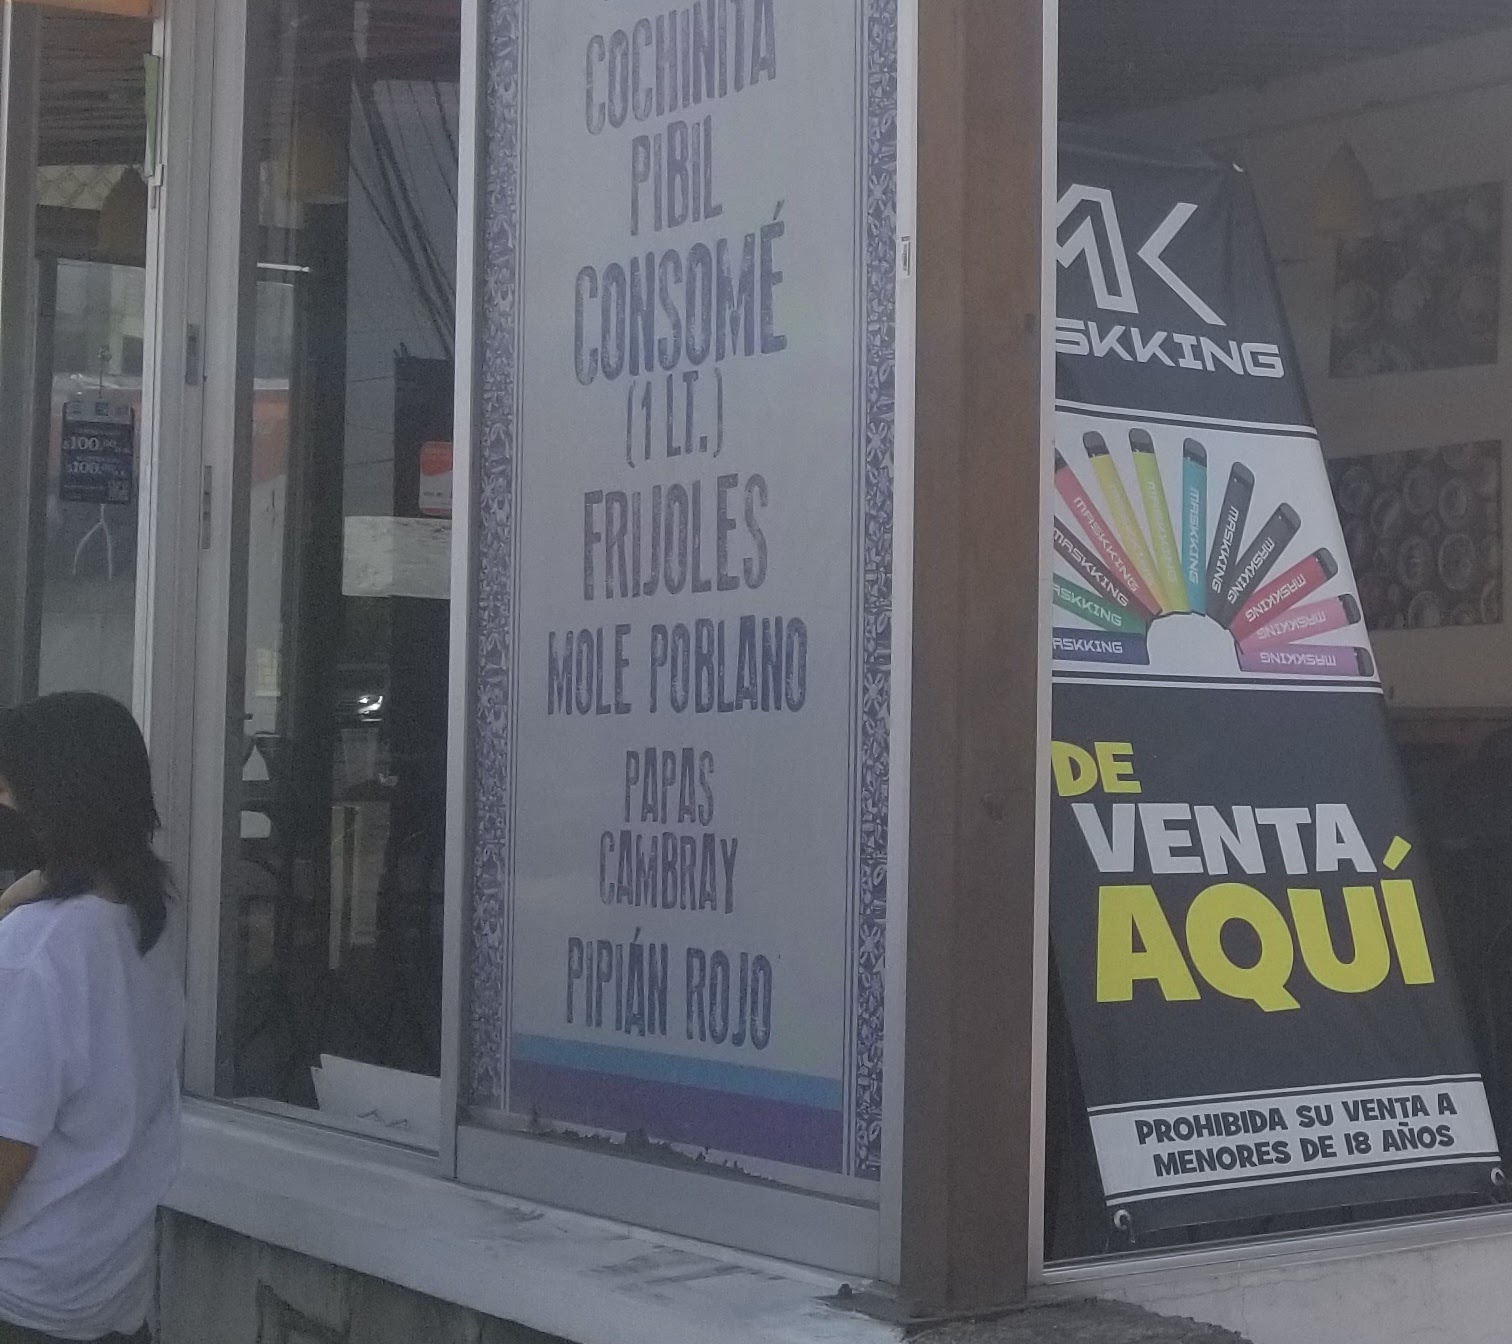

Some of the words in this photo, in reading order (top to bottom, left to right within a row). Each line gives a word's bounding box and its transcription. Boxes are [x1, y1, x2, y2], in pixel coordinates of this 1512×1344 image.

[630, 114, 723, 237] PIBIL
[574, 199, 788, 386] CONSOMÉ
[625, 374, 653, 469] (1
[666, 365, 723, 459] LT.)
[582, 472, 769, 602] FRIJOLES
[1052, 528, 1130, 607] MASKKING
[1074, 496, 1139, 593] MASKKING
[1189, 487, 1199, 585] MASKKING
[1211, 505, 1240, 594] MASKKING
[1227, 536, 1276, 605] MASKKING
[1245, 574, 1307, 623] MASKKING
[1257, 610, 1327, 640] MASKKING
[547, 622, 632, 716] MOLE
[649, 614, 808, 716] POBLANO
[1259, 651, 1337, 667] MASKKING
[623, 746, 715, 827] PAPAS
[1051, 740, 1142, 797] DE
[599, 829, 739, 915] CAMBRAY
[1071, 803, 1377, 875] VENTA
[1096, 835, 1436, 1013] AQUÍ
[566, 926, 668, 1037] PIPIÁN
[685, 946, 773, 1051] ROJO
[1134, 1106, 1289, 1145] PROHIBIDA
[1298, 1103, 1334, 1128] SU
[1342, 1093, 1430, 1124] VENTA
[1436, 1092, 1458, 1116] A
[1153, 1140, 1292, 1178] MENORES
[1300, 1136, 1338, 1162] DE
[1344, 1130, 1372, 1156] 18
[1382, 1119, 1456, 1152] AÑOS
